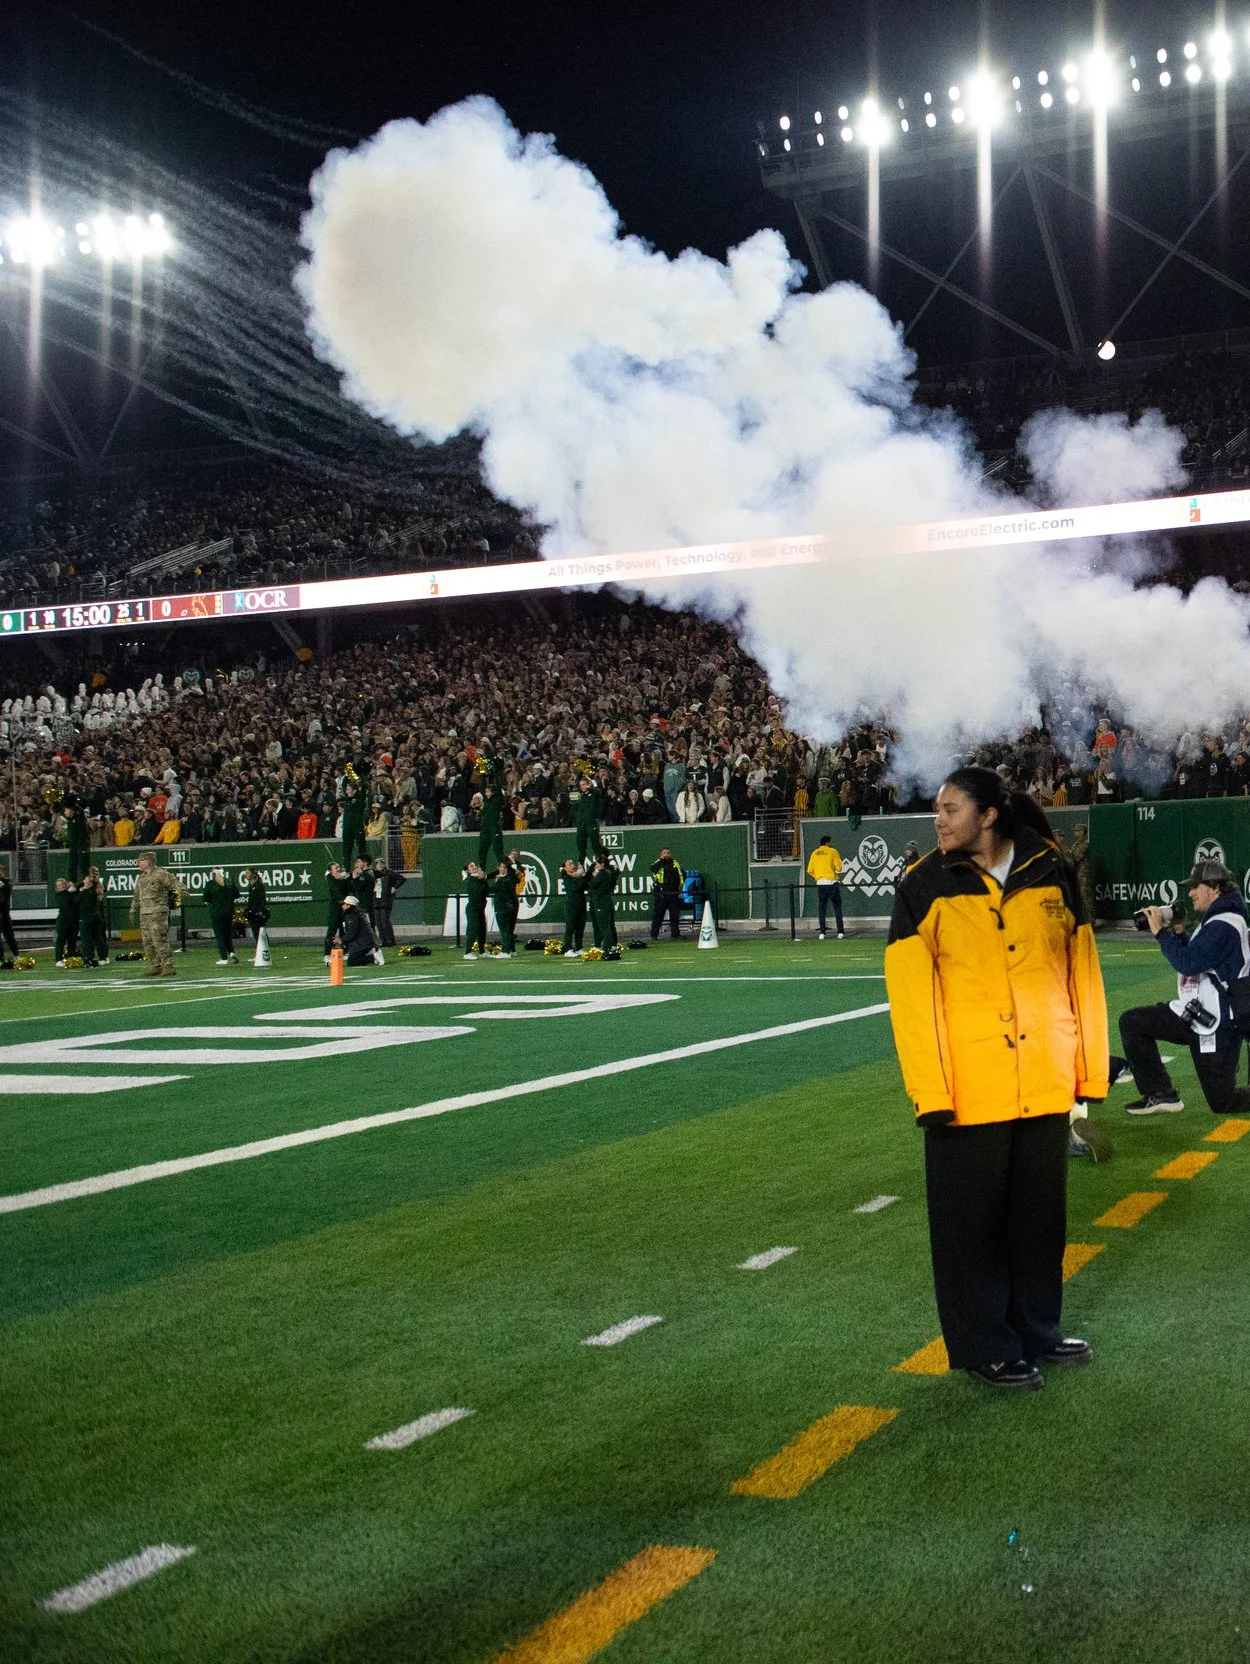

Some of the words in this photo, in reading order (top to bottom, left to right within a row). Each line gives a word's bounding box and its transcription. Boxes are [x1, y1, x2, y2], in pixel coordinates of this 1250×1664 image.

[926, 516, 1075, 542] EncoreElectric.com
[548, 566, 565, 578] All
[567, 561, 613, 577] Things
[615, 557, 661, 572] Power,
[664, 548, 747, 567] Technology,
[780, 541, 830, 557] Energy
[161, 600, 172, 617] 0
[244, 589, 289, 610] OCR
[1, 614, 13, 631] 0
[28, 611, 37, 626] 1
[62, 604, 112, 628] 15:00
[135, 602, 144, 617] 1
[1136, 806, 1156, 821] 114
[600, 834, 618, 847] 112
[105, 859, 138, 868] COLORADO
[172, 851, 186, 862] 111
[583, 853, 638, 872] NW
[107, 874, 141, 891] ARM
[238, 868, 295, 888] GARD
[1095, 882, 1158, 901] SAFEWAY
